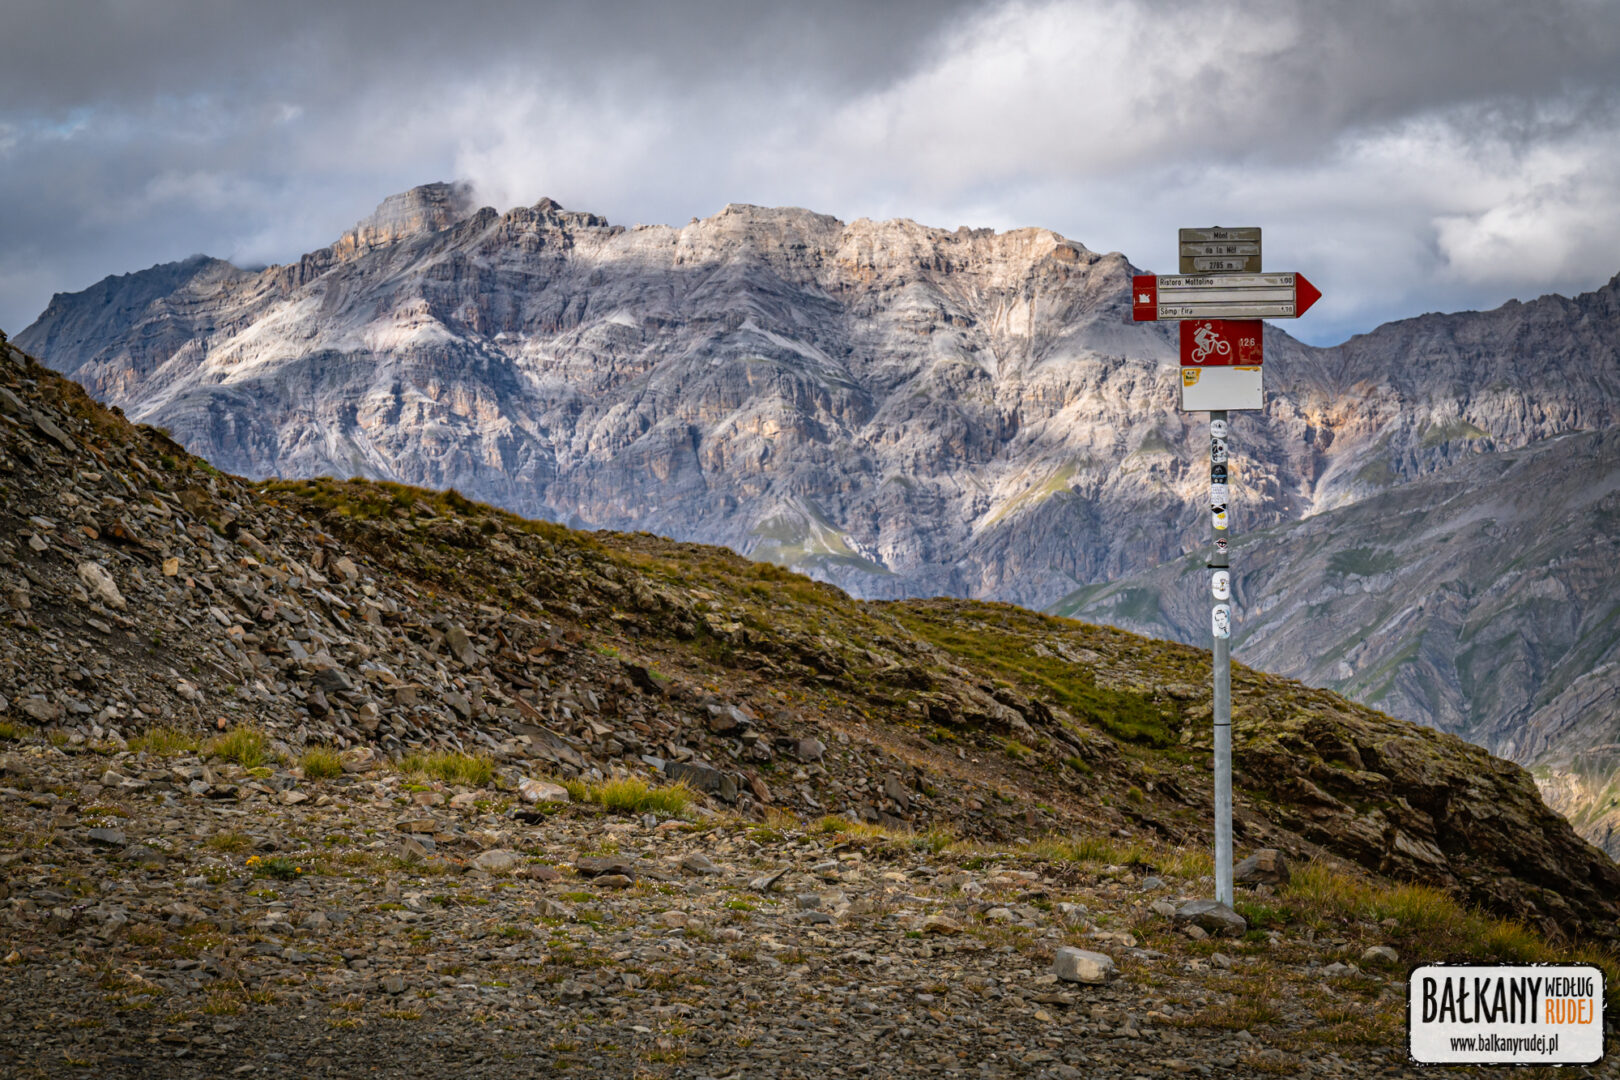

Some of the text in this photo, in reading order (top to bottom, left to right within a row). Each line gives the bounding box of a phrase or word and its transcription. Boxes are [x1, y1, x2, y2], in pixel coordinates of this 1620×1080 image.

[1216, 246, 1223, 254] la
[1209, 261, 1224, 269] 2785
[1160, 278, 1181, 286] Ristoro
[1240, 337, 1256, 347] 126
